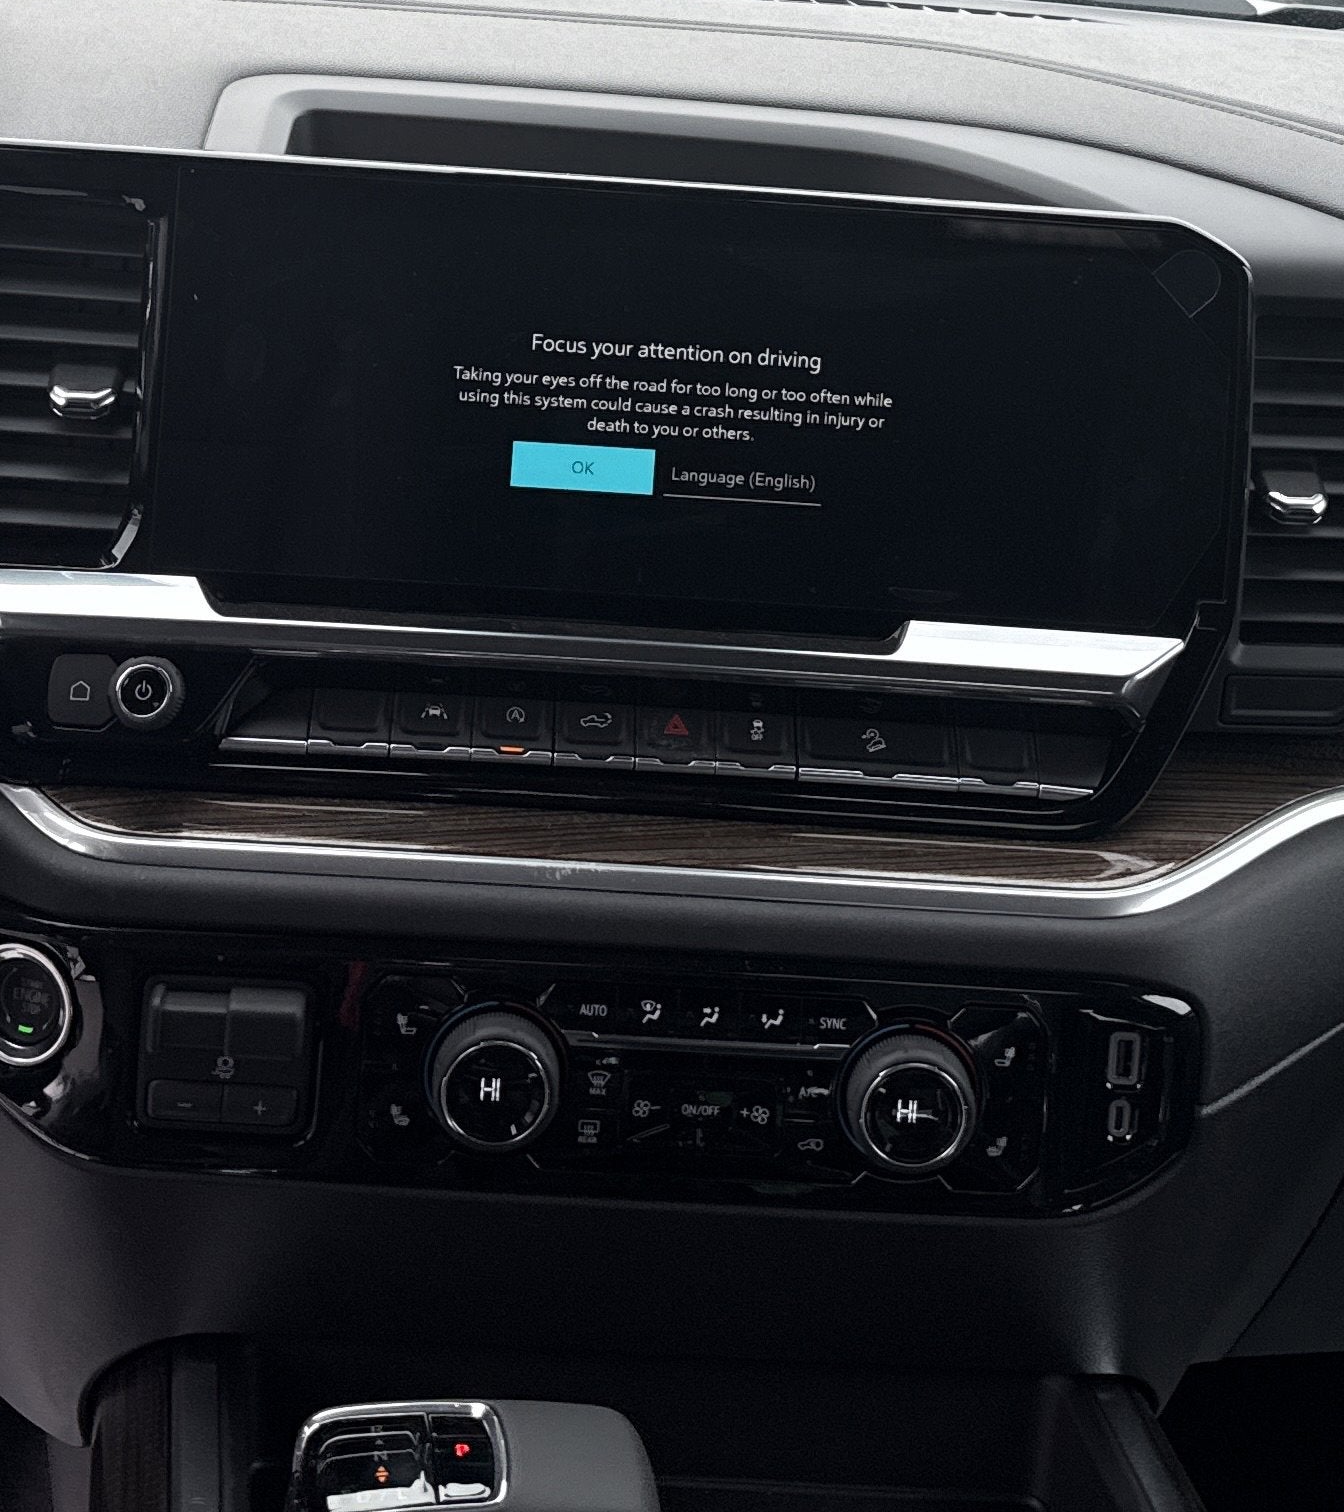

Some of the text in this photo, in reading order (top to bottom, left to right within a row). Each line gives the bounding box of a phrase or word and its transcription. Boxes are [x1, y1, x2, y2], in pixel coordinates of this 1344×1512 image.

[532, 333, 821, 374] Focus your attention on driving
[454, 365, 893, 409] Taking your eyes off the road for too long or too often while
[458, 389, 885, 430] using this system could cause a crash resulting in injury or
[587, 417, 755, 441] death to you or others.
[571, 460, 595, 476] OK
[671, 467, 816, 493] Language (English)
[579, 1003, 608, 1017] AUTO
[819, 1016, 847, 1031] SYNC
[681, 1104, 721, 1117] ON/OFF
